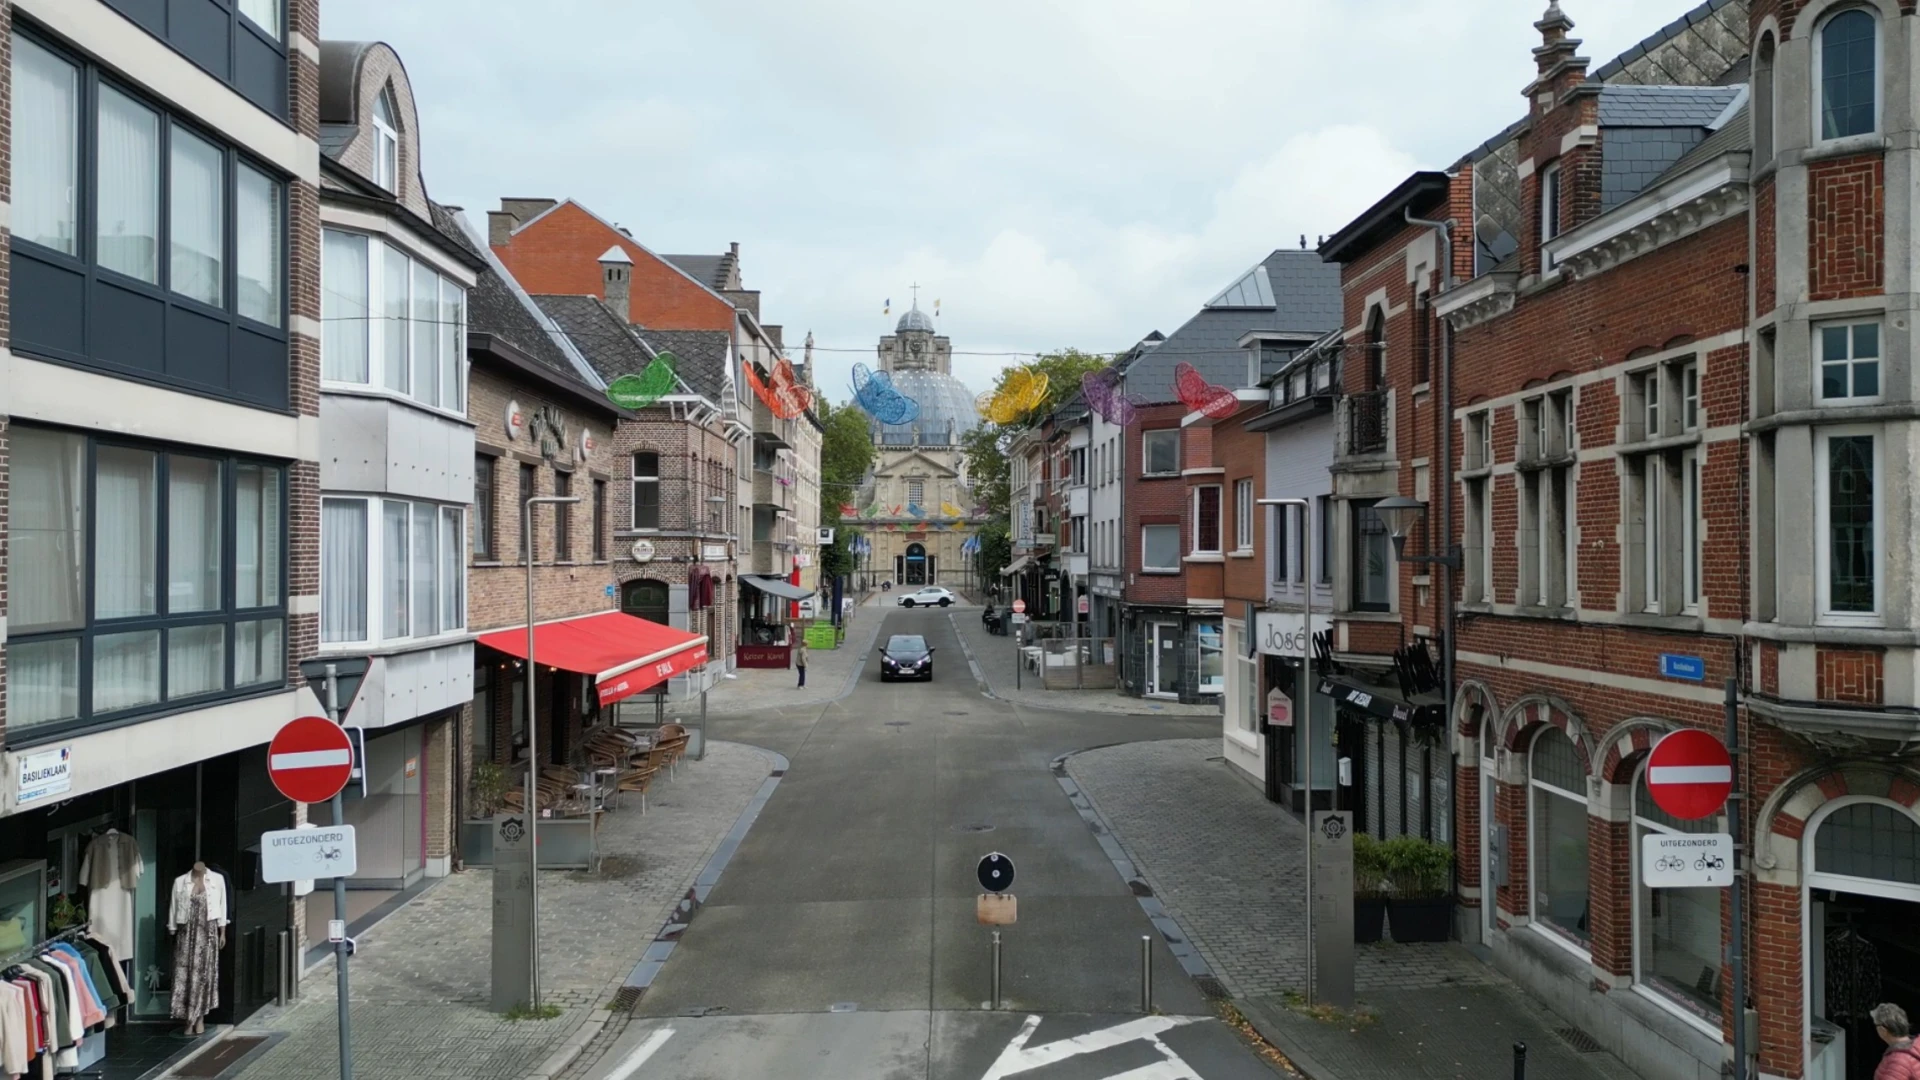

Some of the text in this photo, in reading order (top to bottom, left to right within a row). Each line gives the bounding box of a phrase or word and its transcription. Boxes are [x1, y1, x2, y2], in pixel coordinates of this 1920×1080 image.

[1265, 623, 1306, 651] José
[743, 652, 784, 661] Keizer Karel
[22, 763, 67, 784] BASILIEKLAAN
[272, 833, 343, 847] UITGEZONDERD
[1660, 839, 1718, 848] UITGEZONDERD
